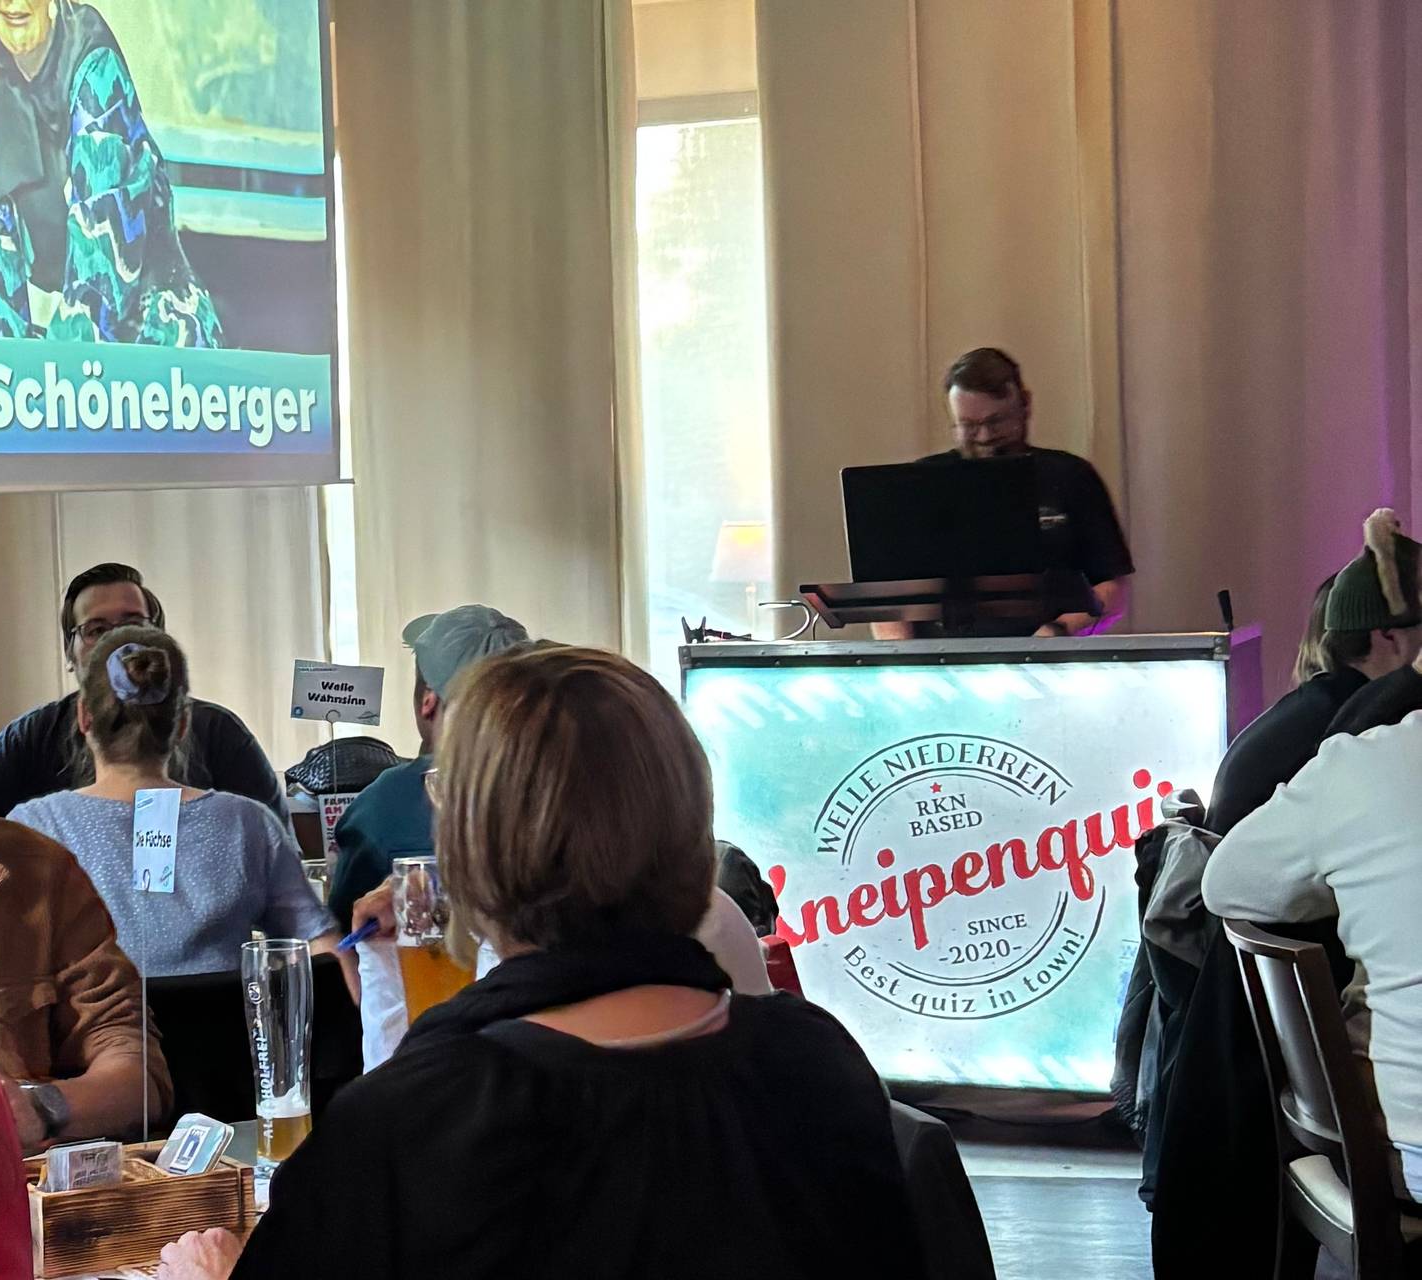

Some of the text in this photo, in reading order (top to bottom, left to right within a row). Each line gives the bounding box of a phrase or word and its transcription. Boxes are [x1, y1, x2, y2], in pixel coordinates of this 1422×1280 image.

[307, 692, 366, 706] Wahnsinn
[321, 681, 354, 693] Welle
[817, 742, 1067, 853] WELLE NIEDERREIN
[916, 793, 968, 817] RKN
[908, 811, 984, 838] BASED
[145, 830, 172, 848] Füchse
[768, 768, 1174, 951] neipenqui
[967, 913, 1028, 936] SINCE
[938, 938, 1023, 965] -2020-
[843, 926, 1086, 1015] Best quiz in town!
